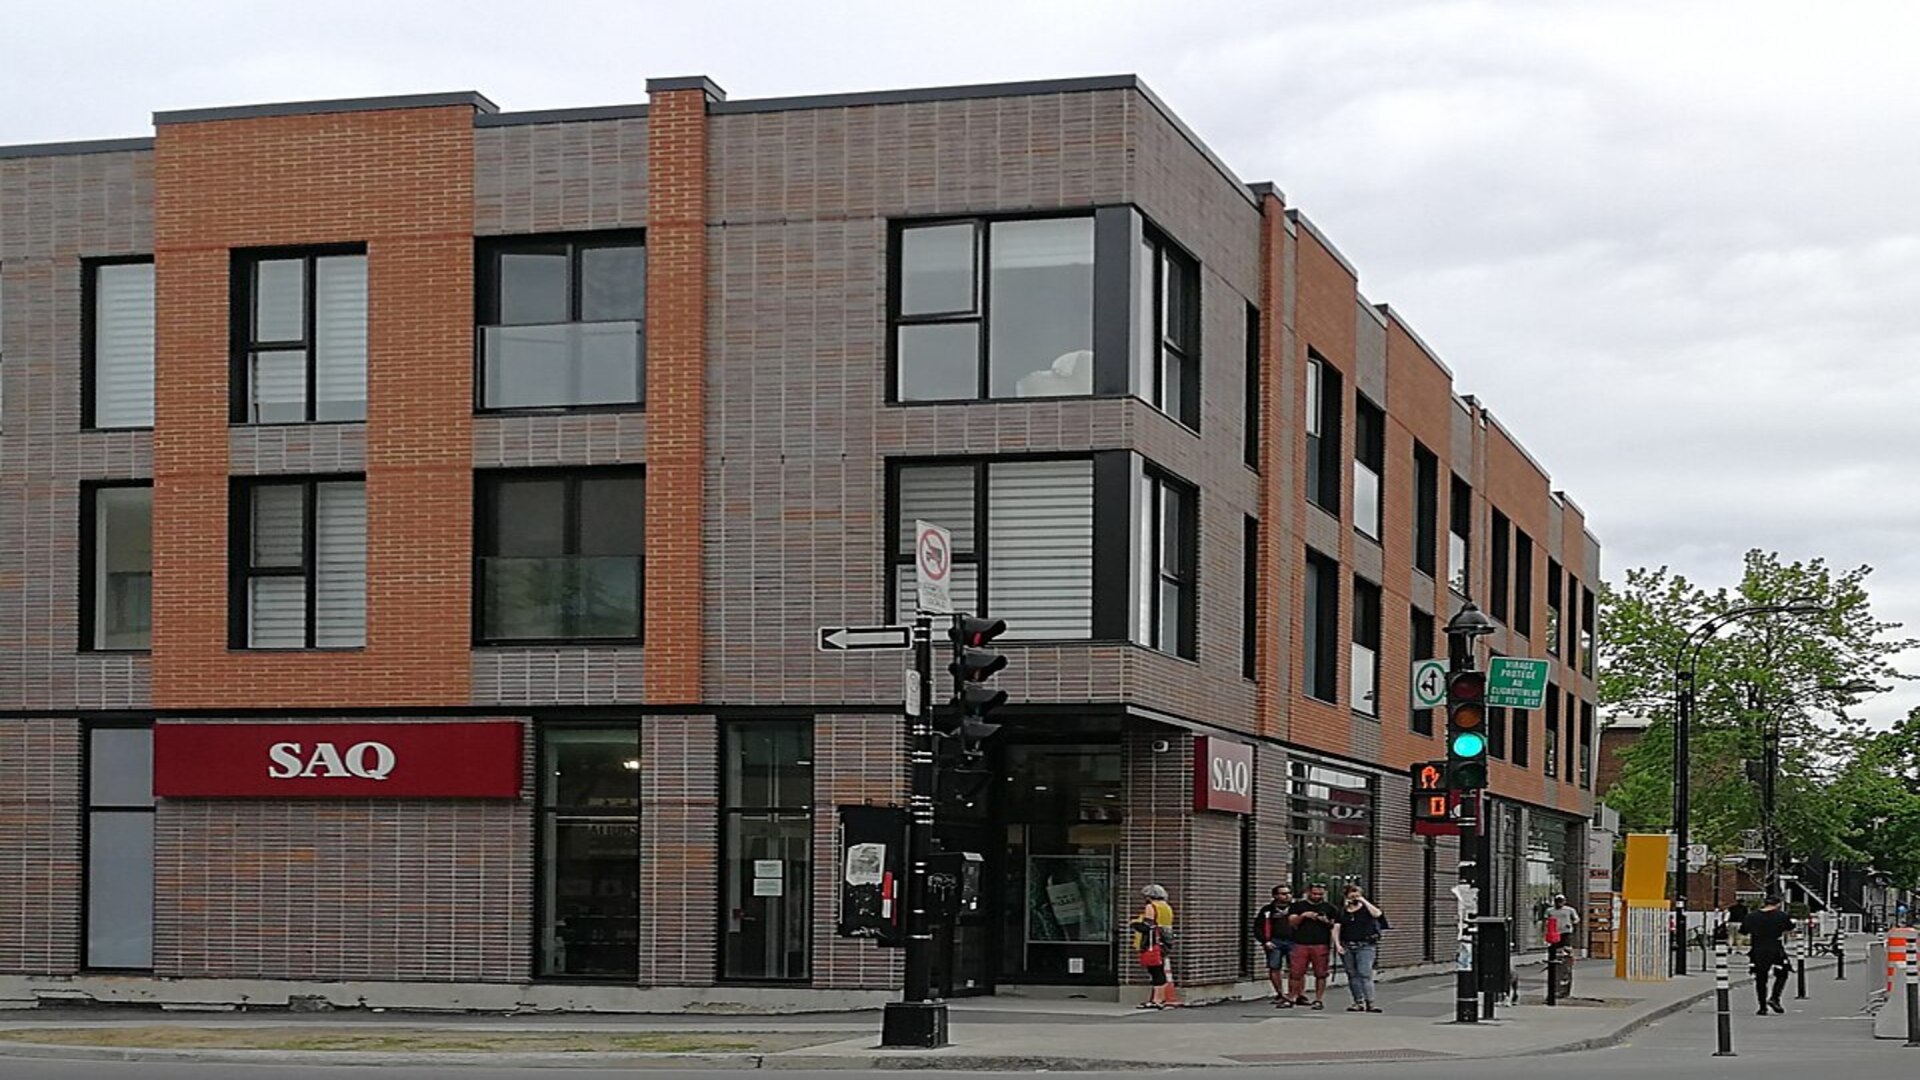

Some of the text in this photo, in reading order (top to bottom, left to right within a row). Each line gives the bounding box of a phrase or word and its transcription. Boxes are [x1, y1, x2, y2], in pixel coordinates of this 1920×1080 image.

[1505, 661, 1535, 670] VIRAGE
[1512, 679, 1523, 687] AU
[268, 742, 396, 780] SAQ
[1213, 757, 1248, 797] SAQ
